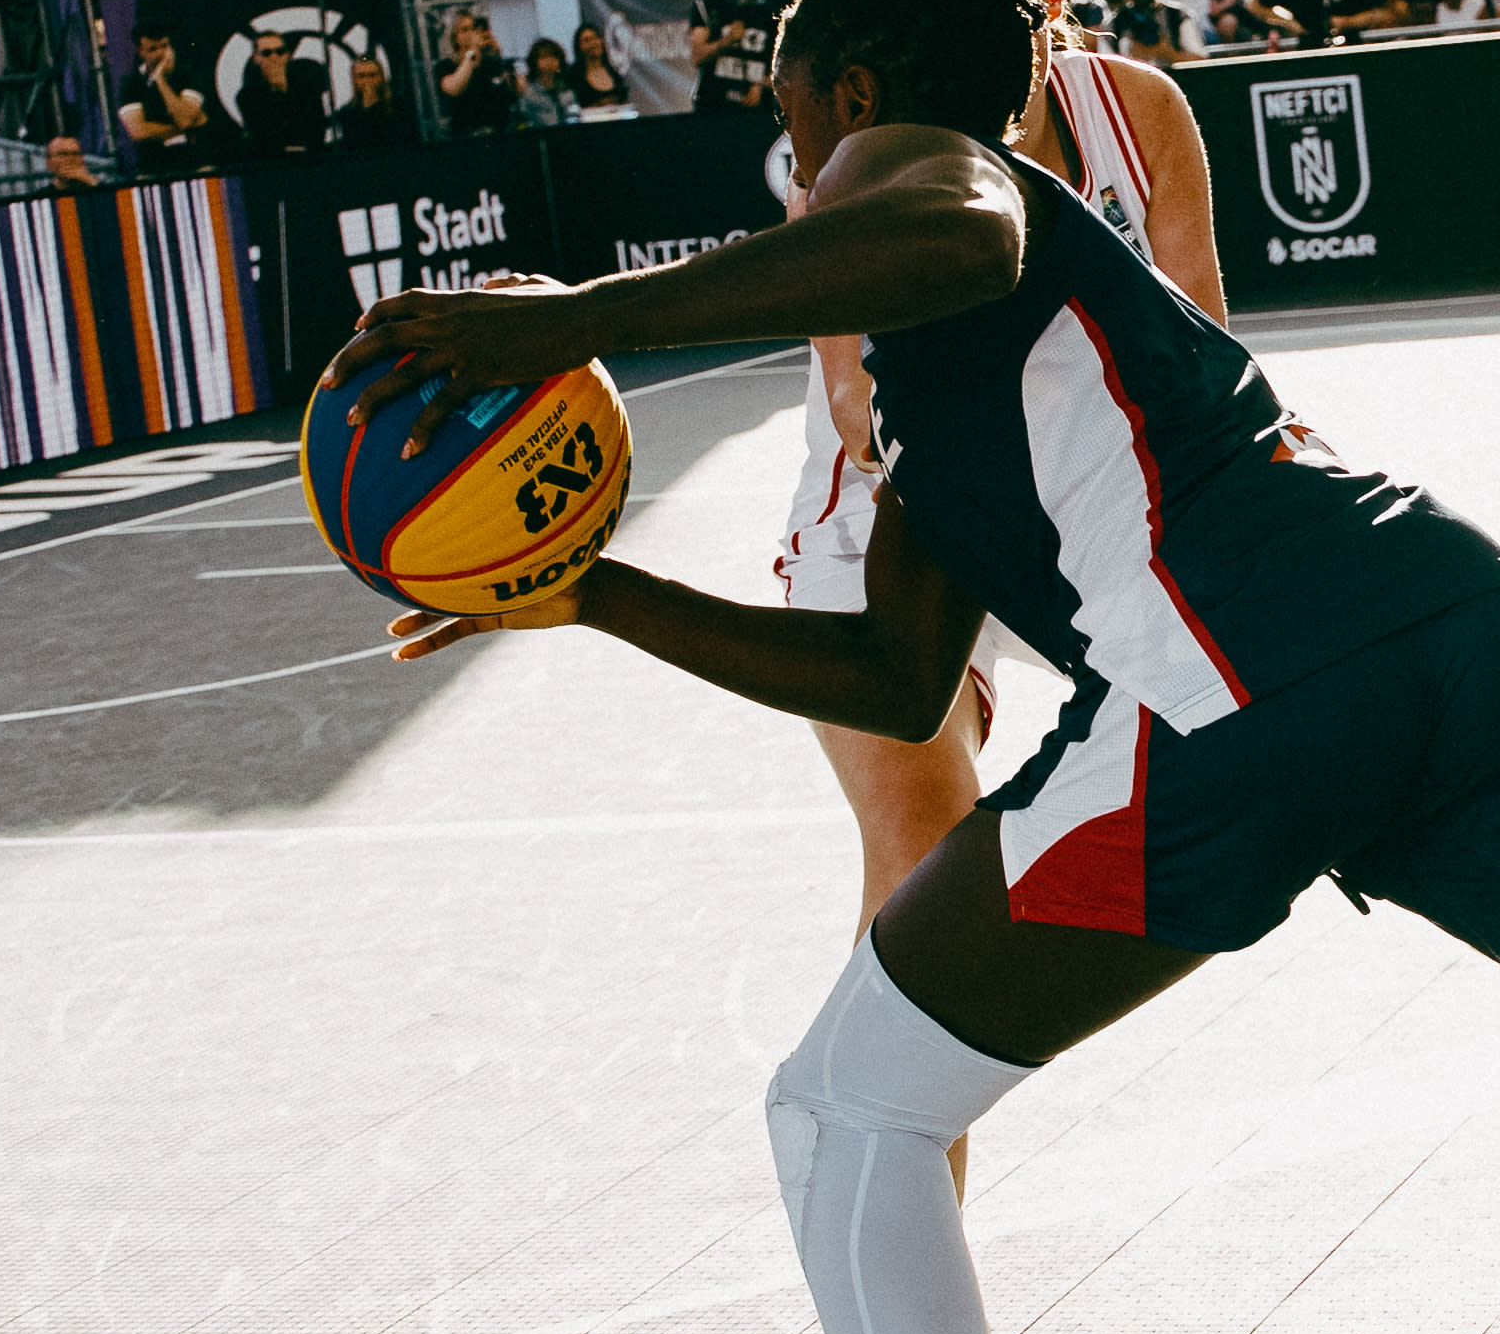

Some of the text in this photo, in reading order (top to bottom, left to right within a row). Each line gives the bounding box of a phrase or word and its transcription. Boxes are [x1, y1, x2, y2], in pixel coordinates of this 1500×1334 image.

[412, 188, 508, 259] Stadt
[1290, 234, 1378, 263] SOCAR
[496, 398, 569, 473] OFFICIAL BALL
[520, 421, 570, 472] FIBA 3x3
